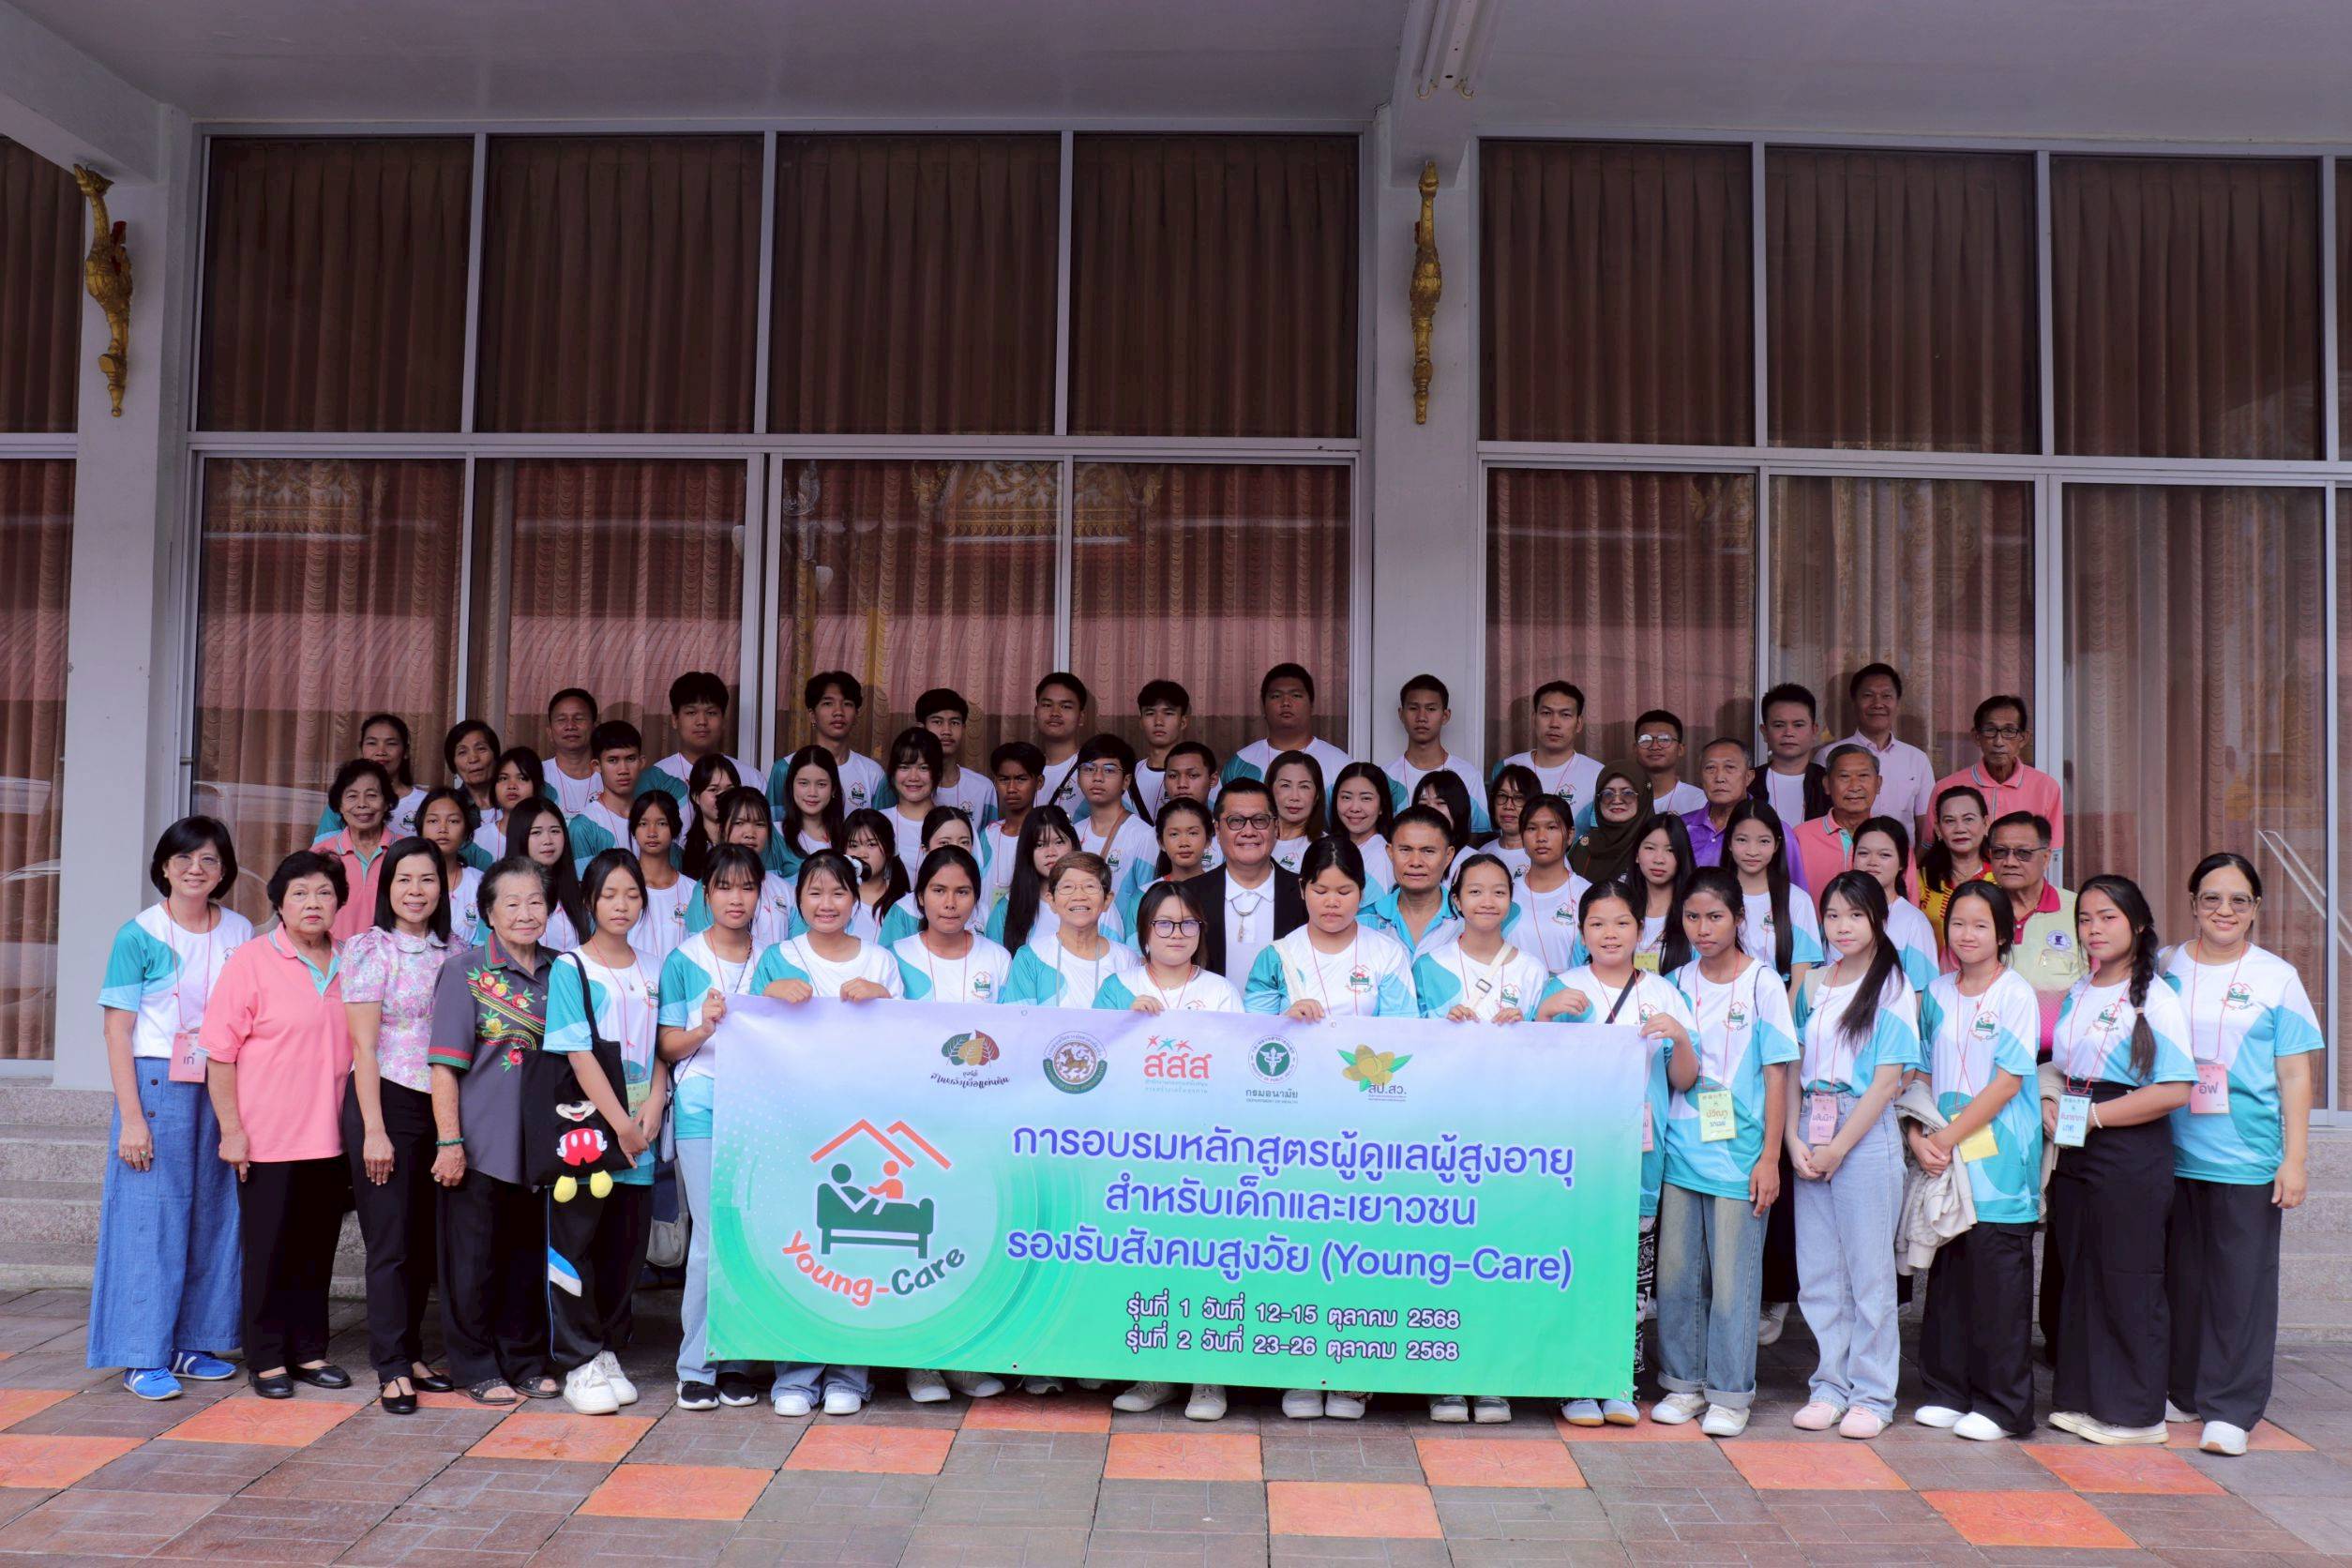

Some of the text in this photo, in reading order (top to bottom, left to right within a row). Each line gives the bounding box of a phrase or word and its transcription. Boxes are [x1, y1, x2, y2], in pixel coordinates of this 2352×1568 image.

[1143, 1051, 1213, 1079] สสส
[1013, 1125, 1574, 1188] การอบรมหลักสูตรผู้ดูแลผู้สูงอายุ
[1105, 1171, 1476, 1226] สำหรับเด็กและเยาวชน
[782, 1229, 966, 1307] Young-Care
[1007, 1224, 1572, 1290] รองรับสังคมสูงวัย (Young-Care)
[1126, 1288, 1460, 1333] รุ่นที่ 1 วันที่ 12-15 ตุลาคม 2568
[1125, 1319, 1459, 1364] รุ่นที่ 2 วันที่ 23-26 ตุลาคม 2568
